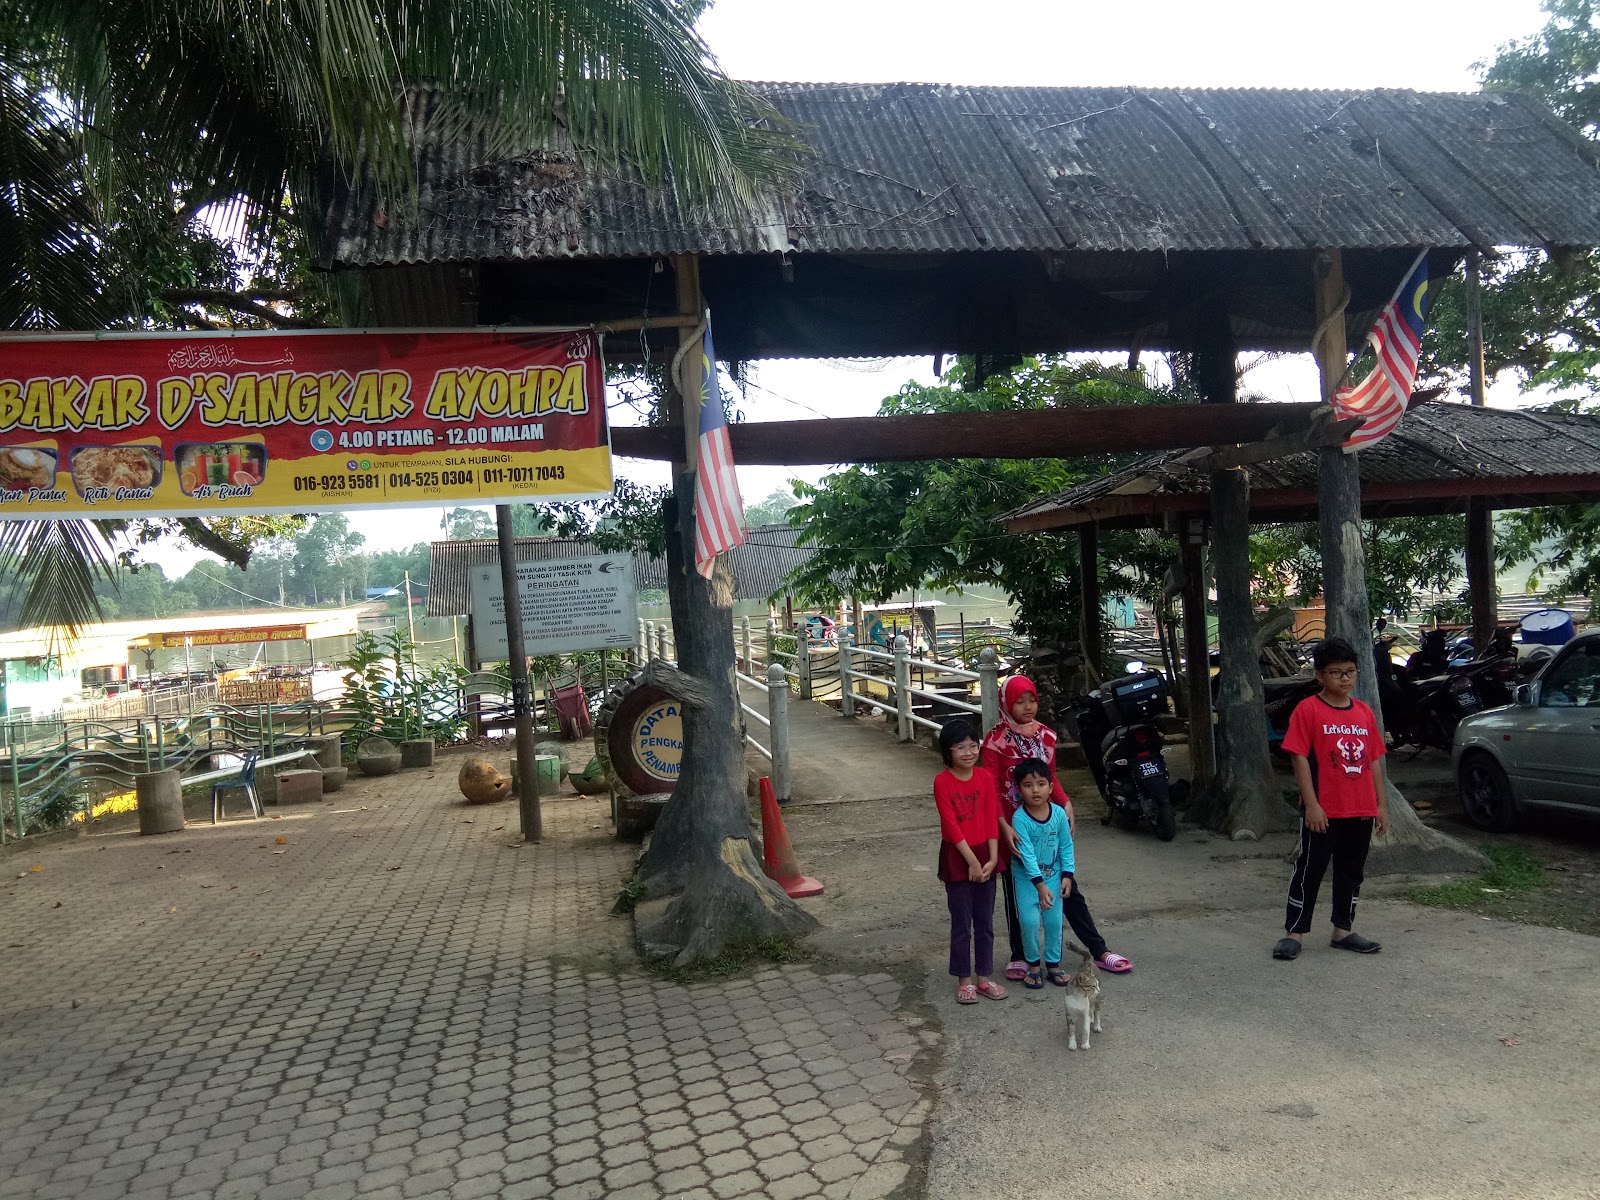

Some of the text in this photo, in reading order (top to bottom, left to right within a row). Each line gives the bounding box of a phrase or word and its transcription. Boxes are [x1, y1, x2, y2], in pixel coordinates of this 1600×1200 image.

[0, 361, 589, 430] BAKAR D'SANGKAR AYOHPA
[338, 431, 374, 448] 4.00
[377, 429, 434, 447] PETANG
[446, 427, 488, 445] 12.00
[491, 423, 544, 443] MALAM
[401, 460, 444, 468] TEMPAHAN,
[445, 457, 466, 466] SILA
[468, 454, 513, 465] HUBUNGI:
[294, 474, 379, 491] 016-923 5581
[389, 470, 473, 487] 014-525 0304
[484, 466, 565, 483] 011-7071 7043
[27, 485, 67, 504] Panas
[84, 486, 110, 505] Roti
[193, 483, 254, 501] Air Buah
[527, 579, 579, 589] PERINGATAN
[640, 706, 681, 736] DATA
[1341, 725, 1351, 735] Go
[1140, 762, 1155, 770] TCL
[1142, 767, 1159, 776] 2191
